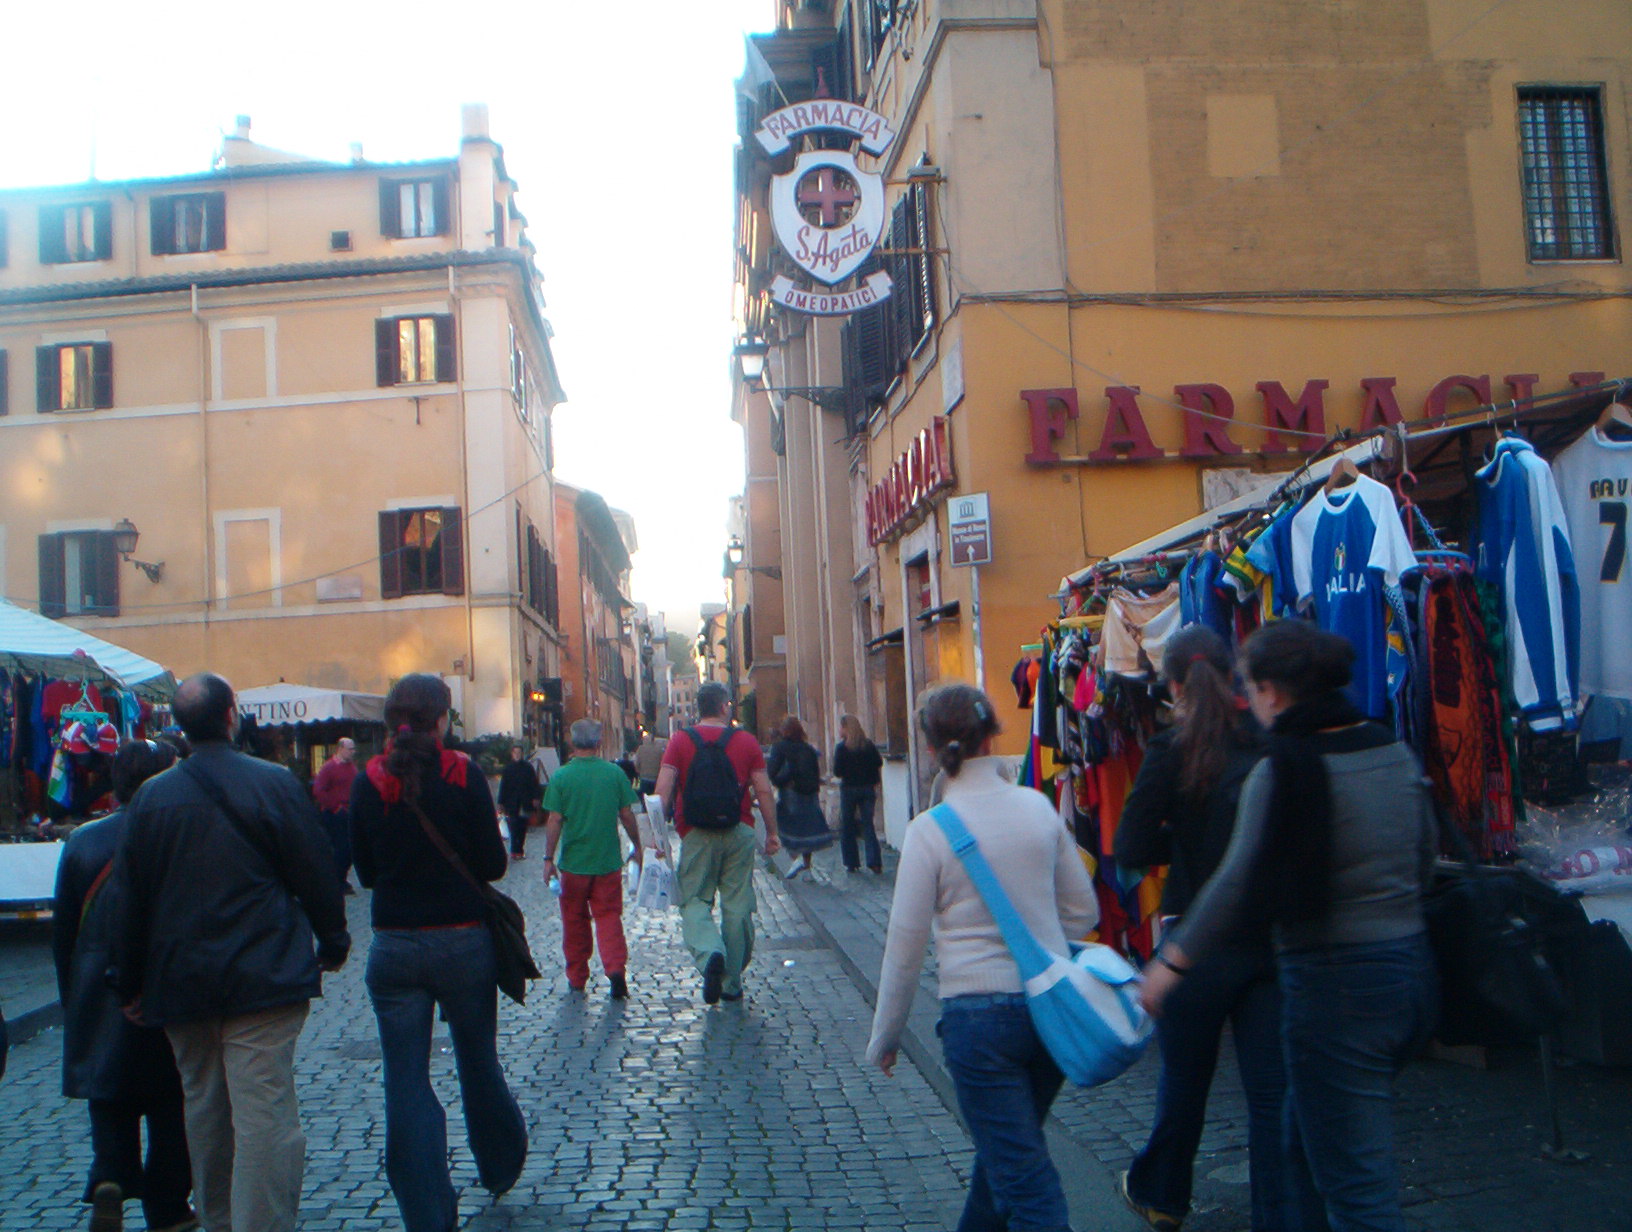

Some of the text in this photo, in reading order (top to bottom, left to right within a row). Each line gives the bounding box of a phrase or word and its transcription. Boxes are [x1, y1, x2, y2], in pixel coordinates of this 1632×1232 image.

[765, 103, 882, 140] FARMACIA
[785, 289, 877, 311] OMEOPATICI
[1599, 501, 1628, 583] 7
